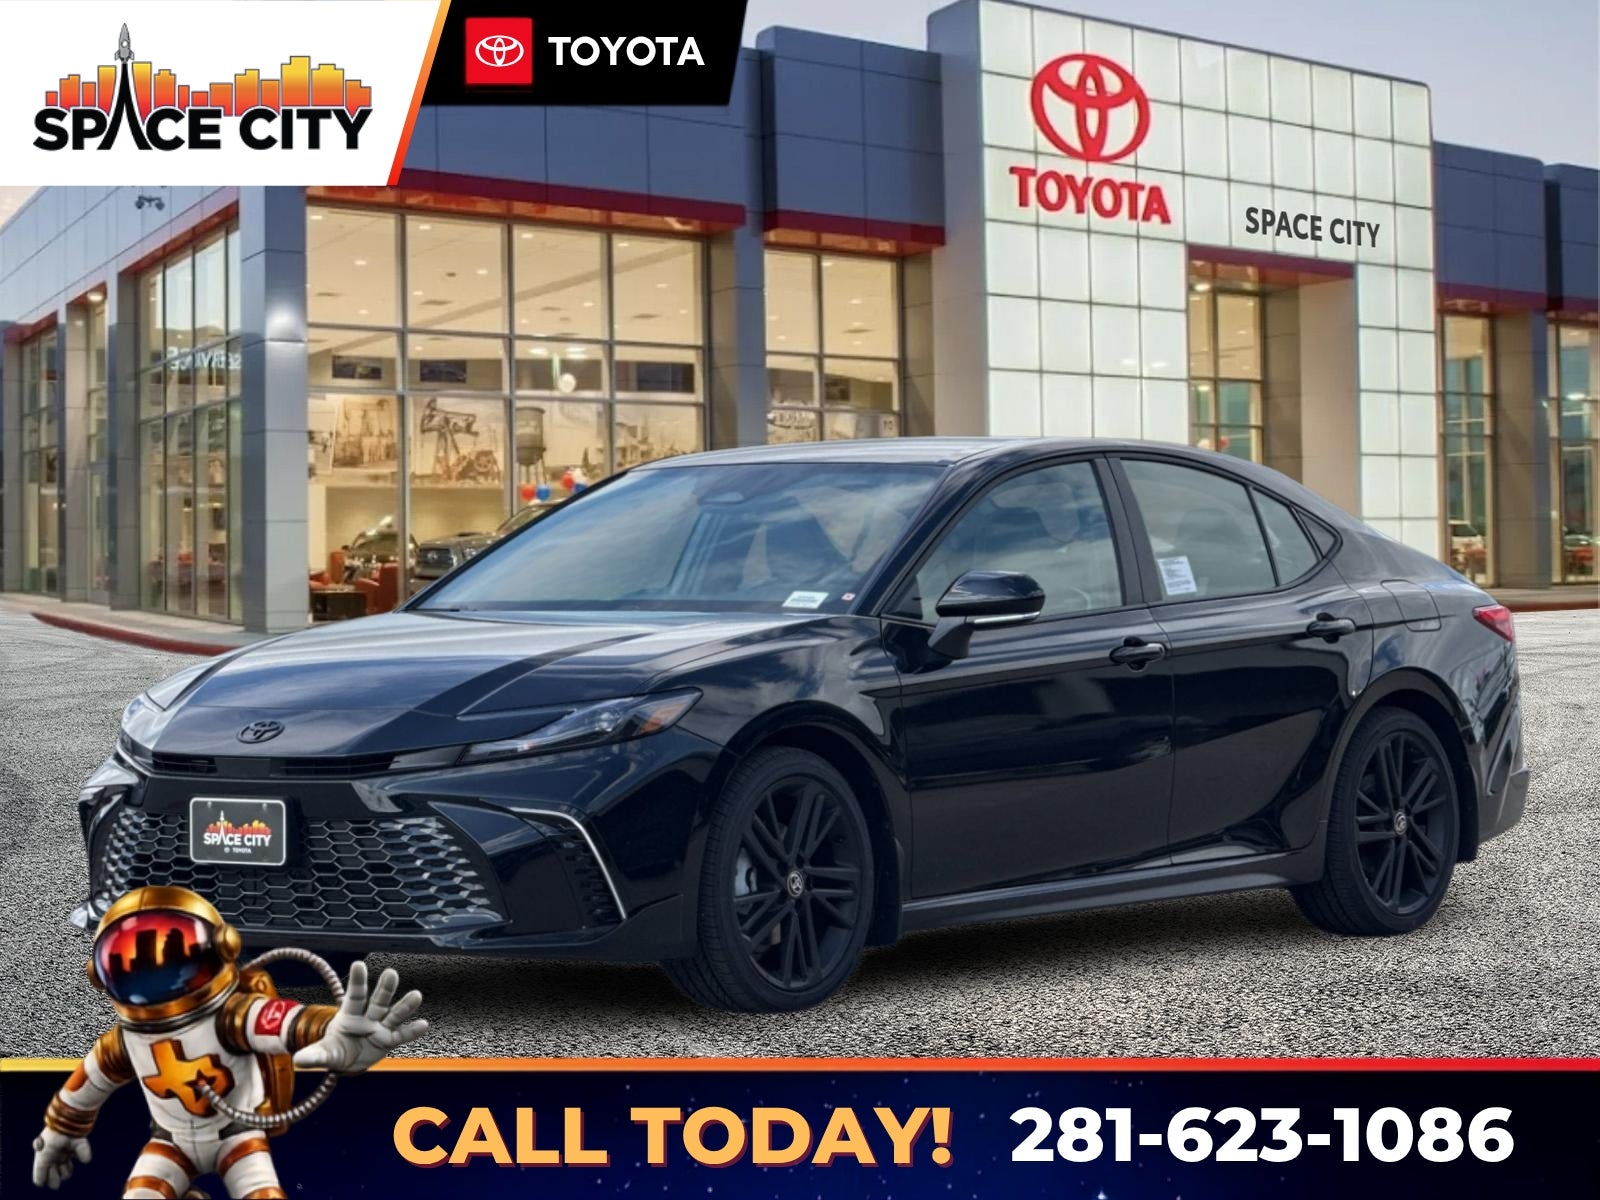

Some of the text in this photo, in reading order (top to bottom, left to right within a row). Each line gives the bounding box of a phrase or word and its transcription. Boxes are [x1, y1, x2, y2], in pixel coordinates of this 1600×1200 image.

[1008, 166, 1172, 225] TOYOTA
[1244, 206, 1381, 249] SPACE CITY
[244, 834, 272, 847] CITY
